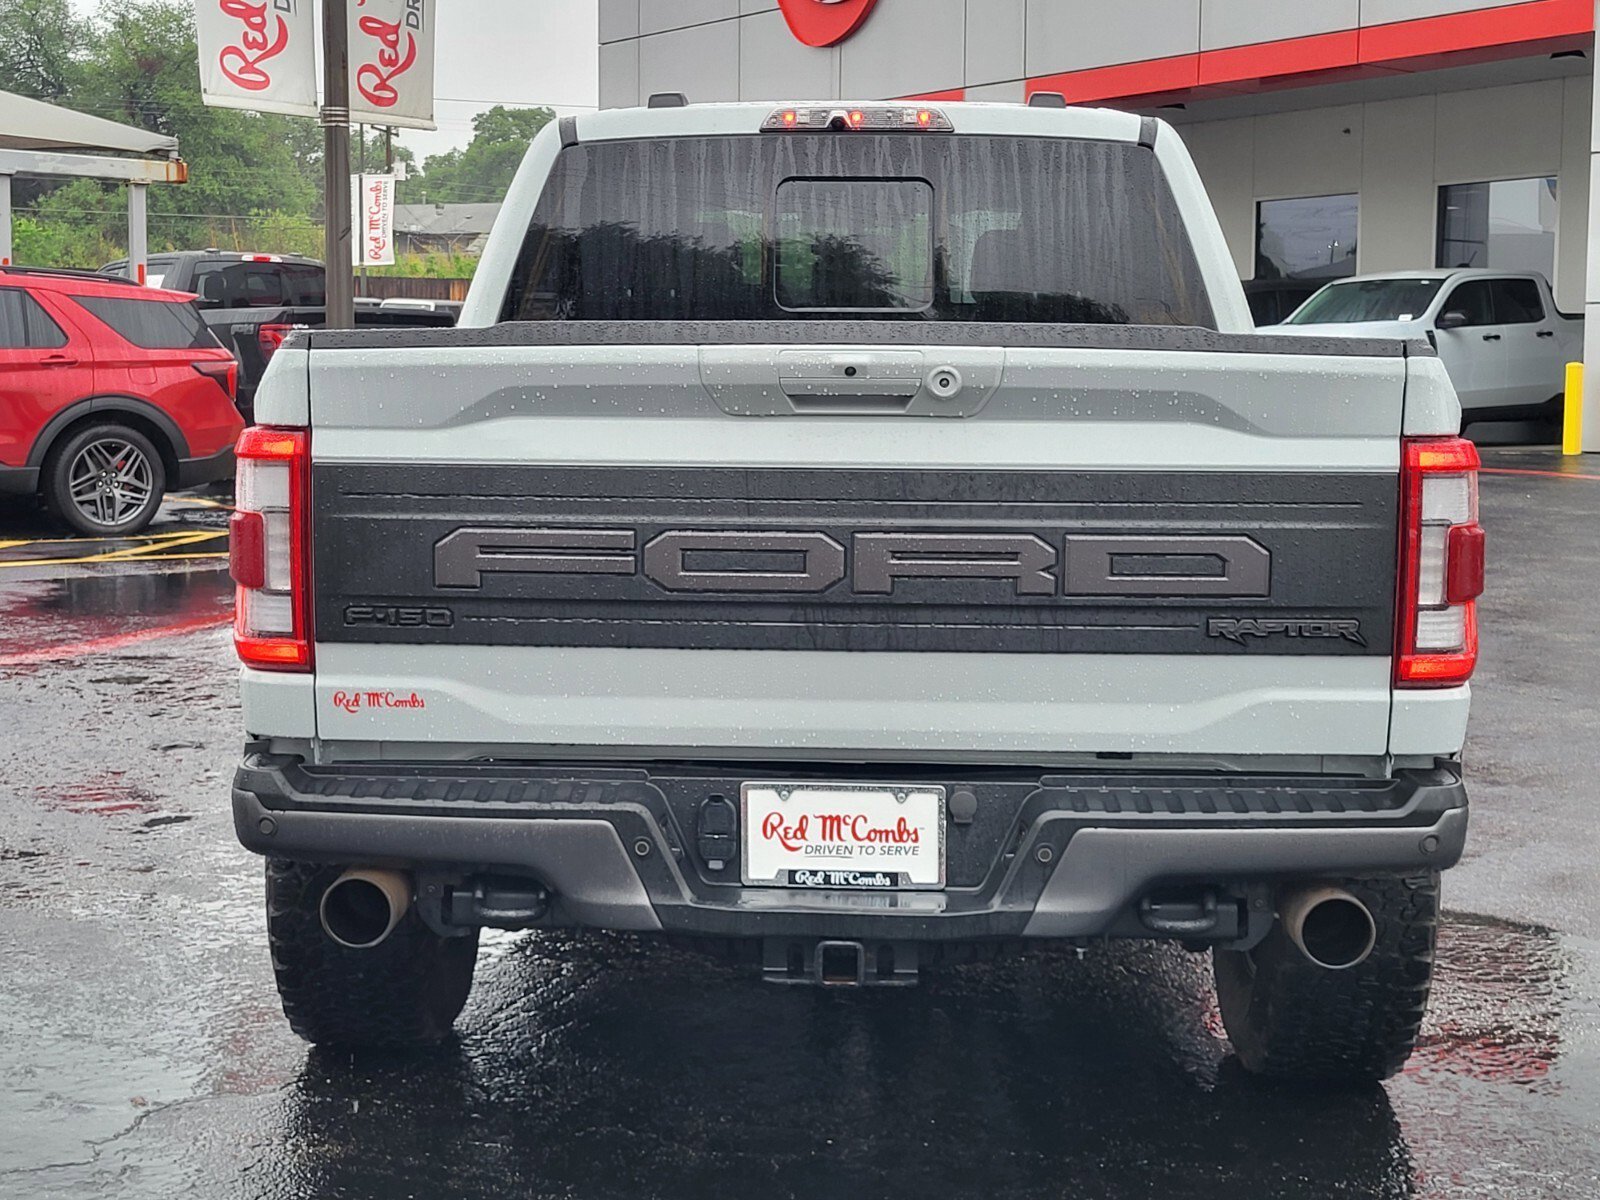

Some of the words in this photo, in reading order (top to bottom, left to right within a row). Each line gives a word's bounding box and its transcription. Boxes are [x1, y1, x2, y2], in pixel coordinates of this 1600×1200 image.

[220, 0, 288, 90] Red
[357, 15, 417, 107] Red
[368, 236, 386, 260] Red
[434, 527, 1272, 598] FORD
[344, 604, 455, 628] F-150
[1207, 616, 1368, 647] RAPTOR
[333, 690, 361, 713] Red
[364, 691, 425, 708] McCombs
[762, 811, 810, 852] Red
[813, 813, 920, 844] McCombs
[804, 844, 854, 857] DRIVEN
[857, 845, 876, 857] TO
[879, 845, 920, 857] SERVE
[794, 870, 825, 886] Red
[825, 871, 891, 886] McCombs
